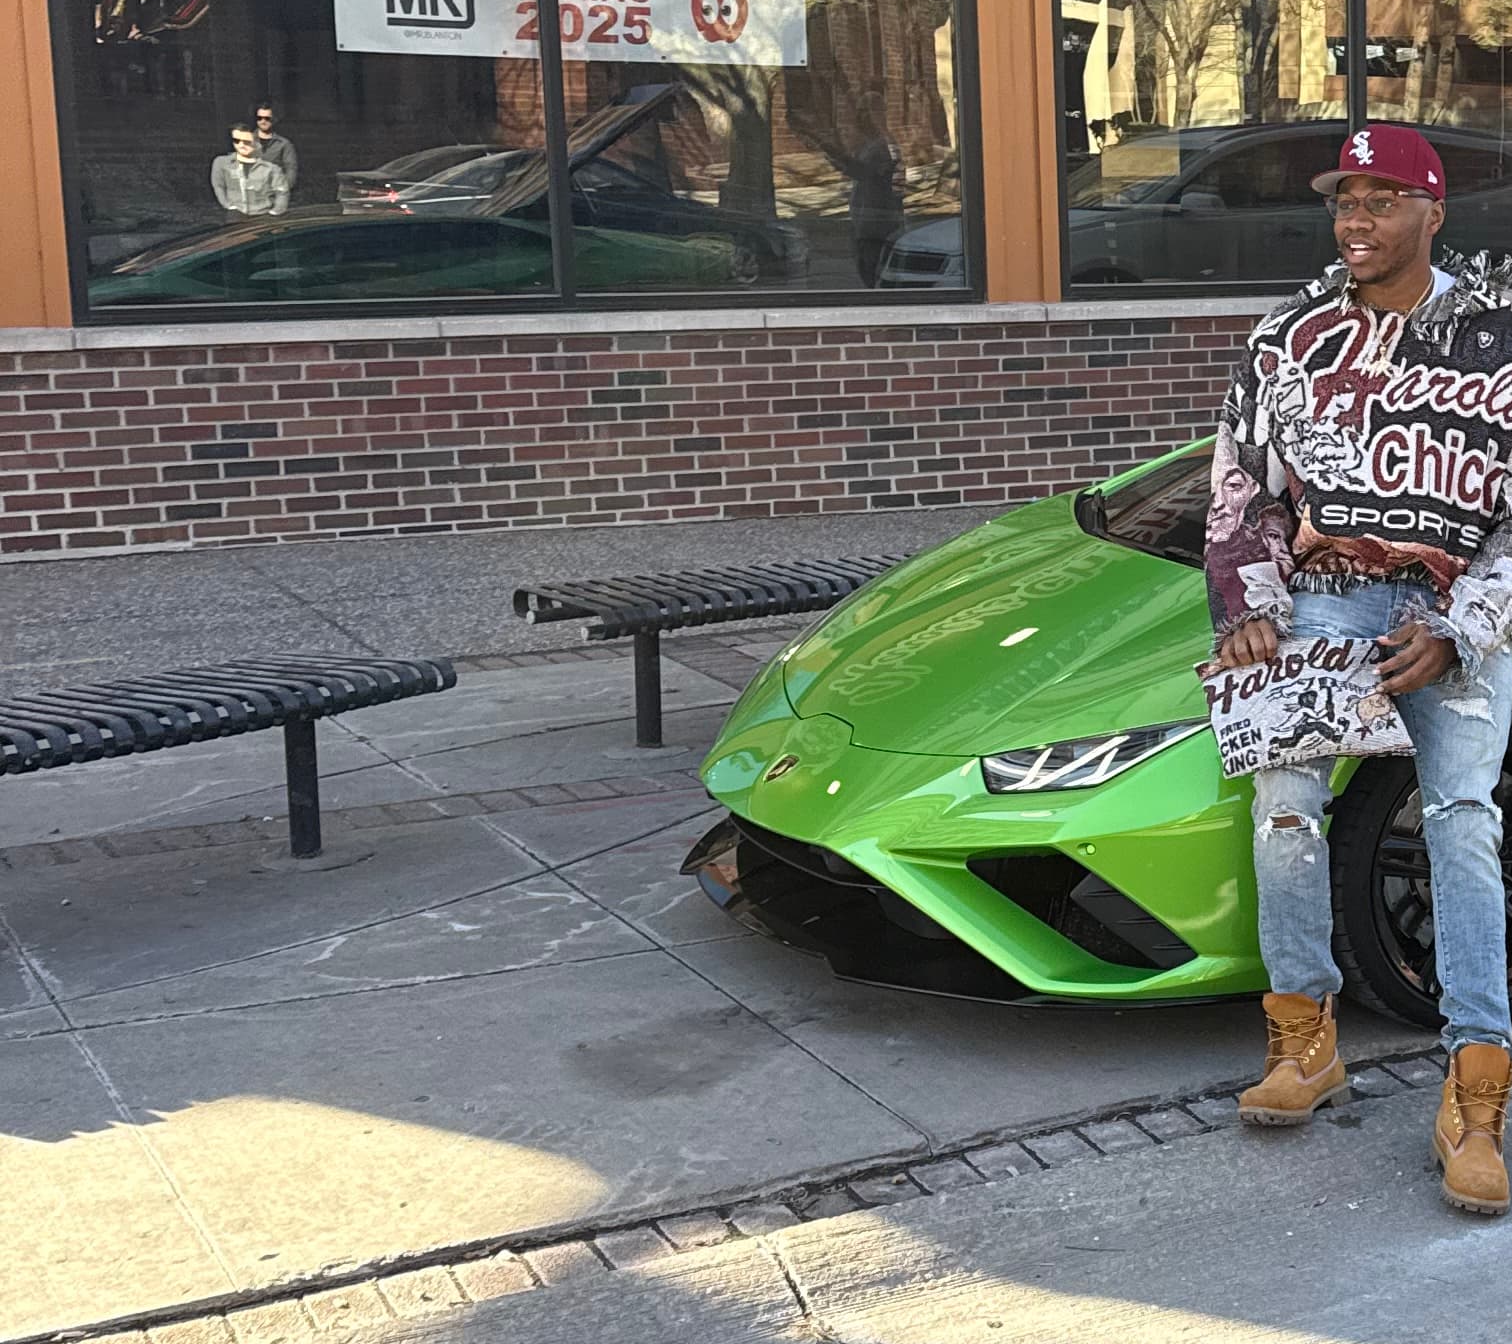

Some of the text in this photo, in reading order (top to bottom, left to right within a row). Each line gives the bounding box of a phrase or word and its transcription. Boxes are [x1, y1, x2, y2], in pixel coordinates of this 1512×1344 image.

[515, 2, 652, 45] 2025
[1320, 505, 1485, 547] SPORTS
[1219, 719, 1251, 739] FRIED
[1220, 728, 1262, 757] CKEN
